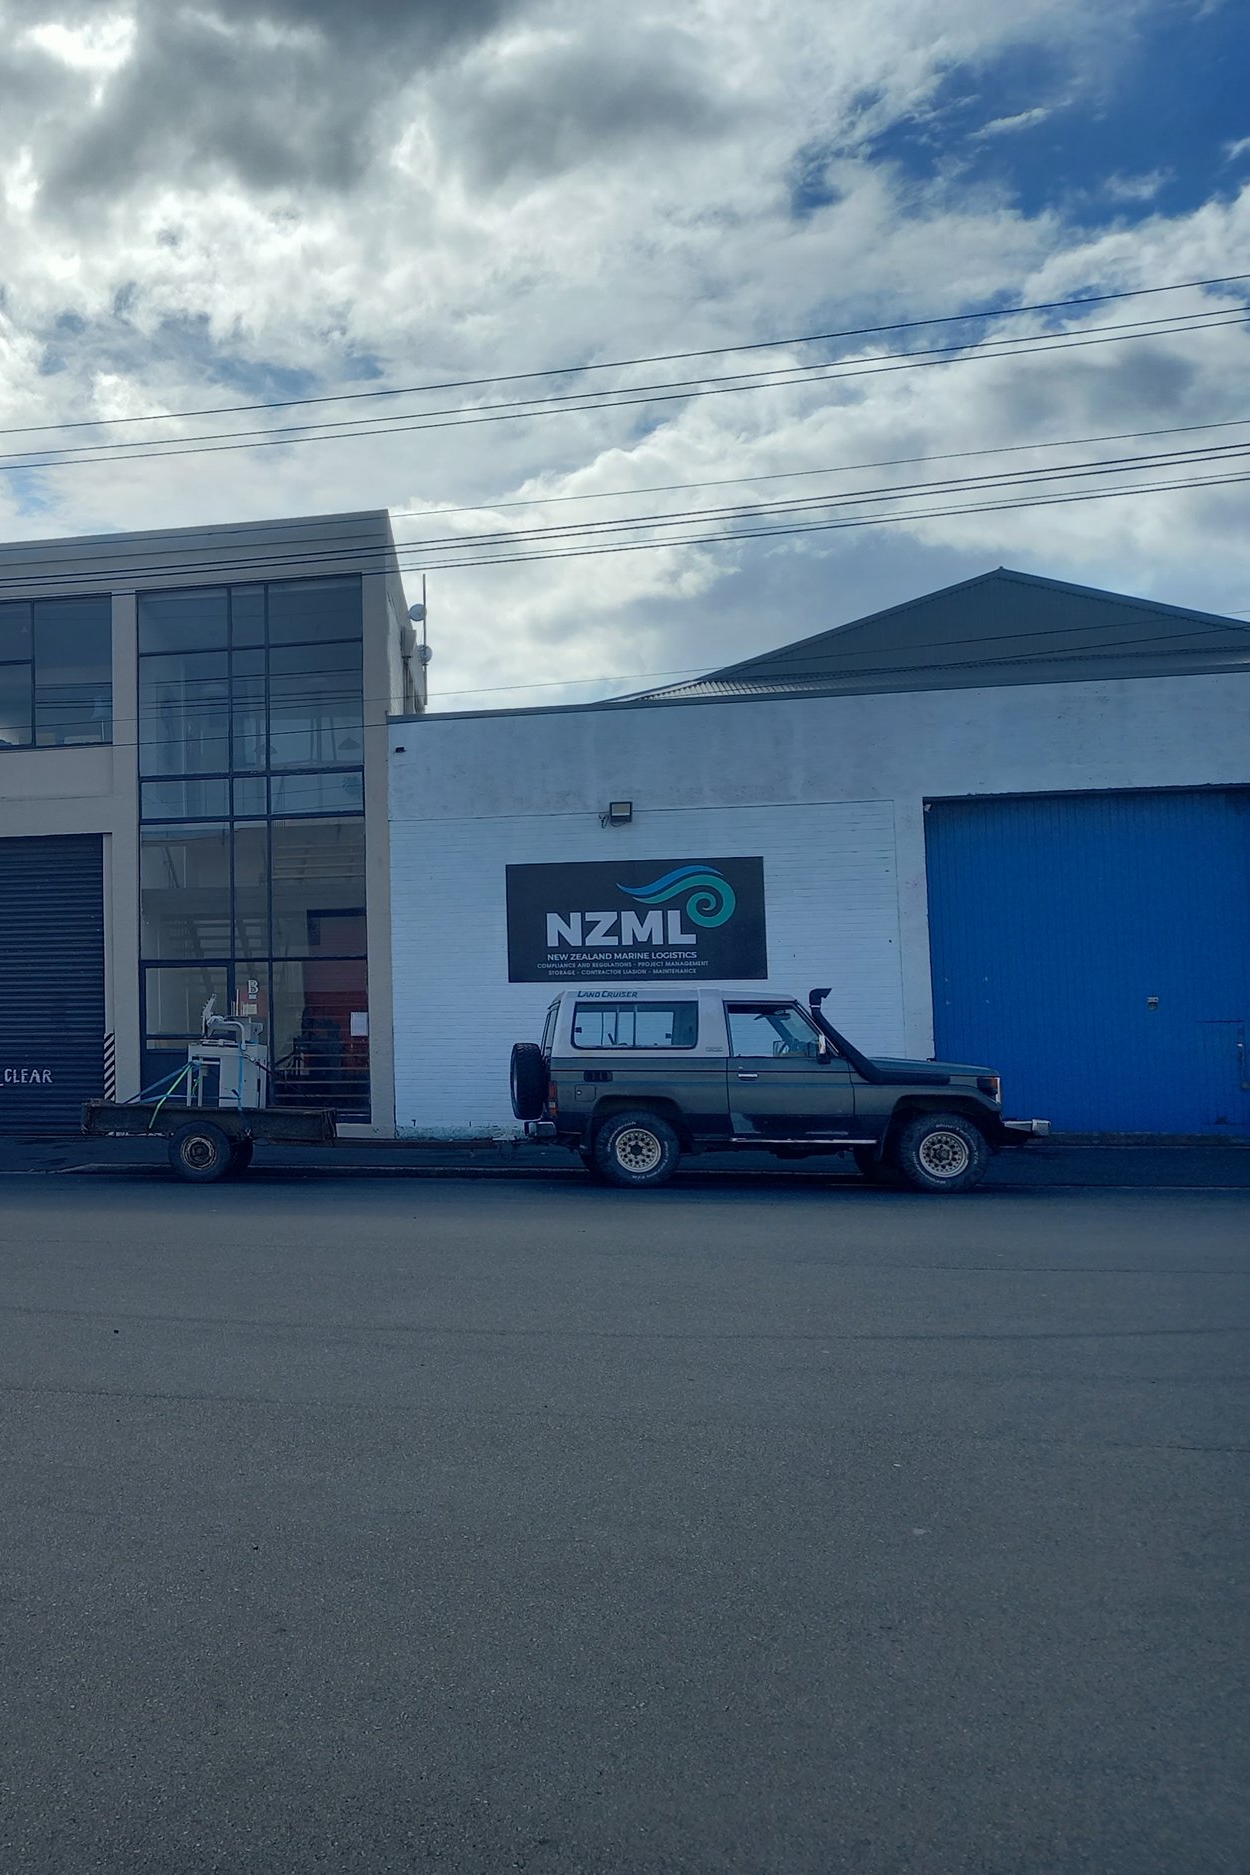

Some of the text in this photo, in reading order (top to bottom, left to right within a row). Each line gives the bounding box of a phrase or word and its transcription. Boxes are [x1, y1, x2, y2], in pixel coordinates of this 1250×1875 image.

[546, 910, 697, 947] NZML
[547, 951, 698, 961] NEW ZEALAND MARINE LOGISTICS
[577, 990, 638, 998] LAND CRUISER
[4, 1068, 53, 1084] CLEAR
